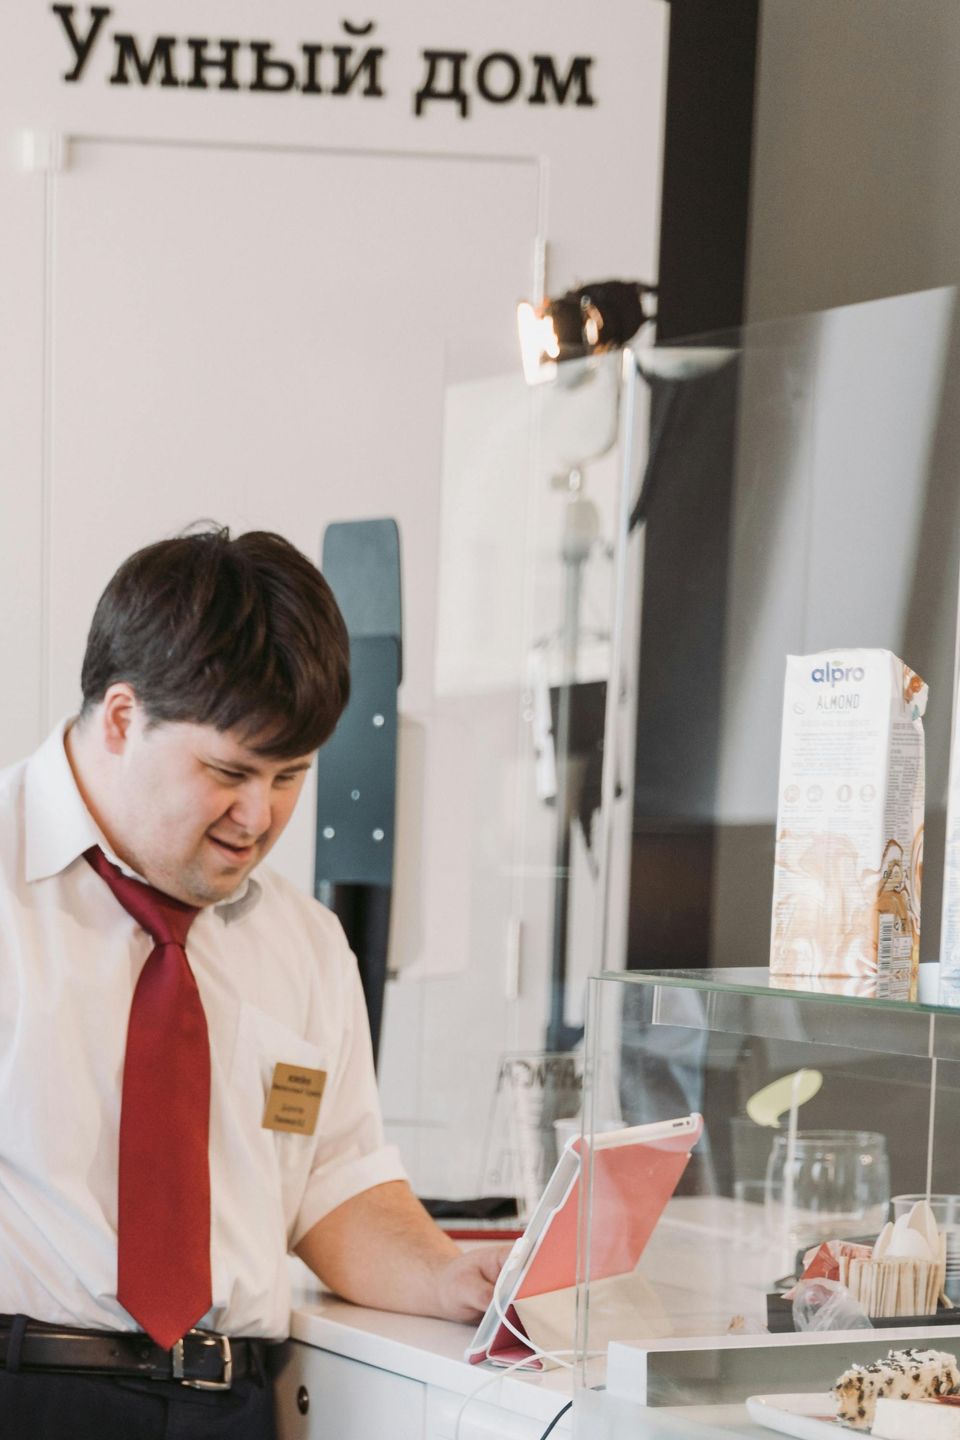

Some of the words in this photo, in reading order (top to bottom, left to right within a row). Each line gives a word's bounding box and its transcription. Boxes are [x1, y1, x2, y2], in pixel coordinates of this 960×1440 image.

[52, 4, 386, 97] Умный
[415, 49, 596, 117] дом
[811, 661, 865, 688] alpro
[816, 694, 860, 711] ALMOND
